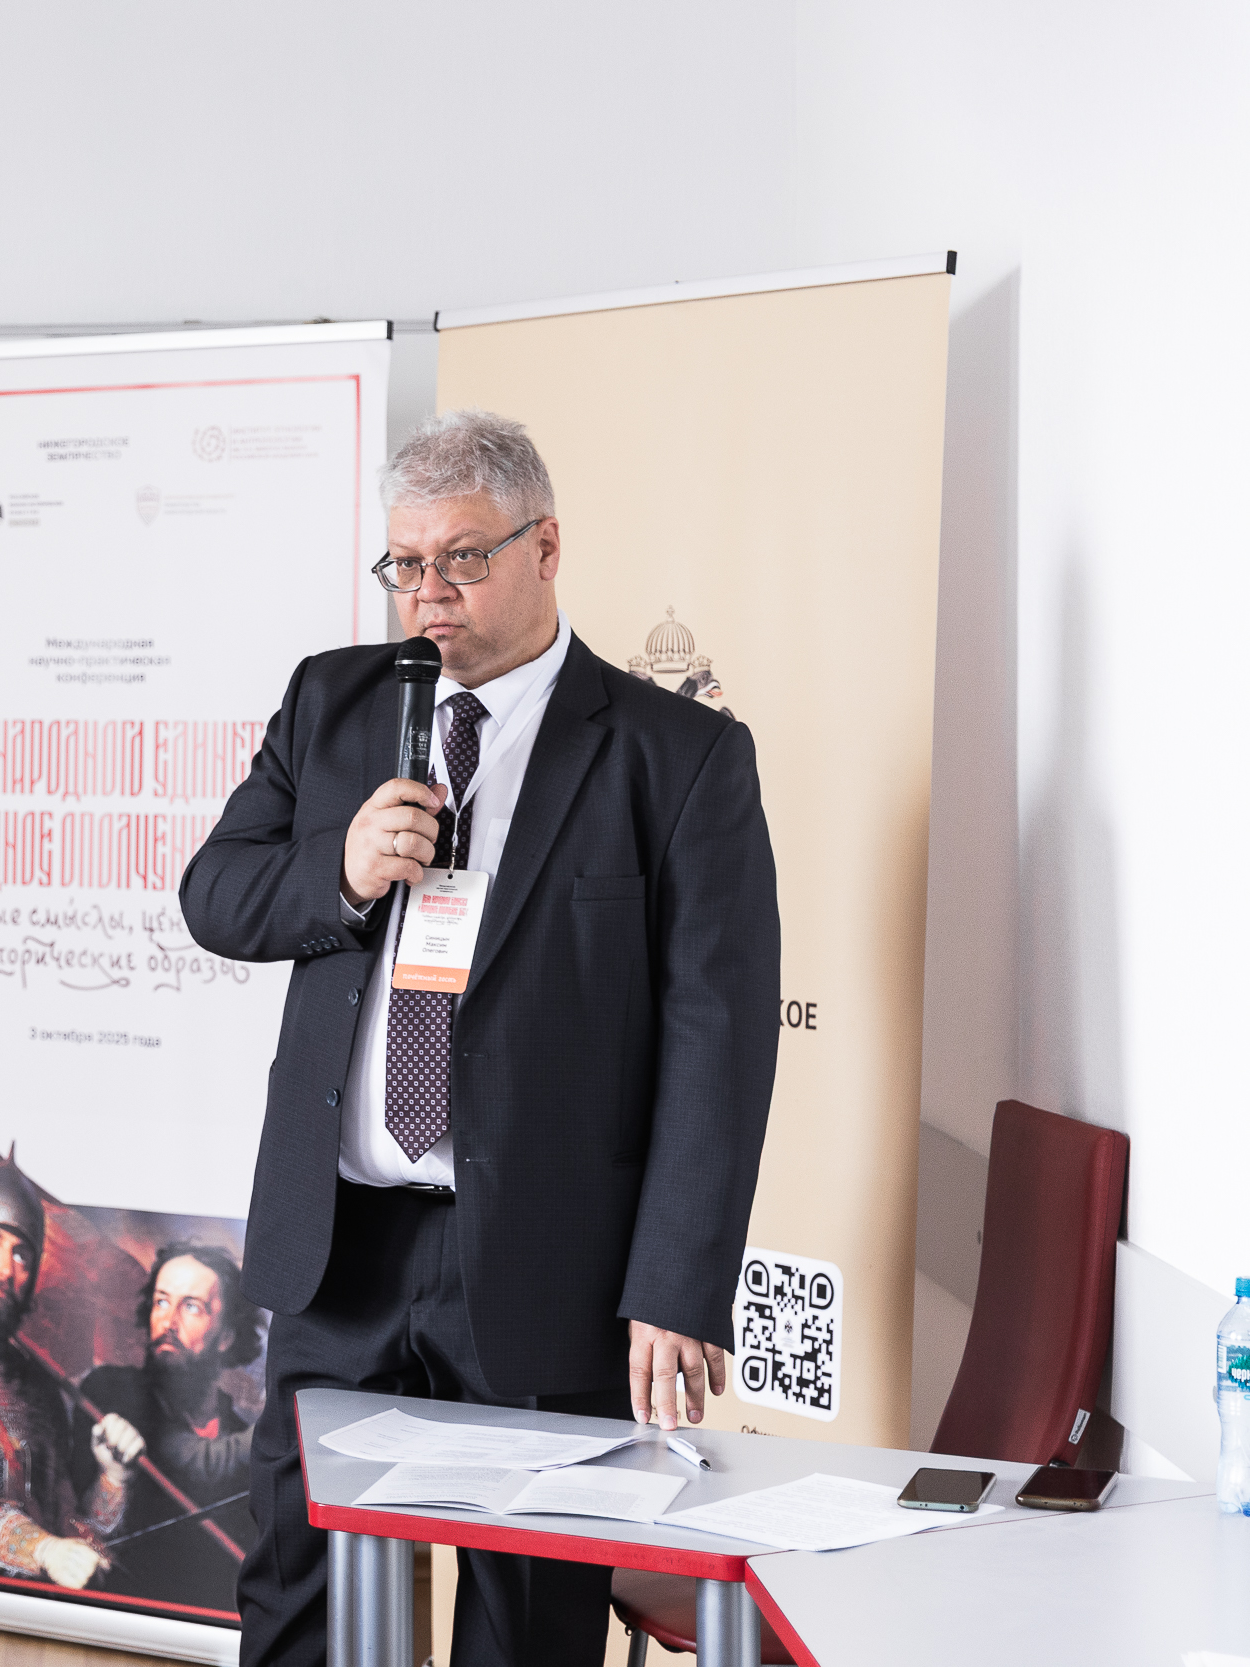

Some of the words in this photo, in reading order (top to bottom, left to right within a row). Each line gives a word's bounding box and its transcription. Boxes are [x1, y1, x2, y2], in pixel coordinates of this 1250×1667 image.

[45, 637, 155, 651] Международная
[28, 656, 171, 669] научно-практическая
[55, 673, 146, 686] конференция
[153, 719, 266, 806] ЕДИНСТ
[141, 905, 183, 942] цен
[28, 1026, 38, 1040] 3
[39, 1028, 94, 1046] октября
[97, 1030, 130, 1046] 2025
[131, 1034, 162, 1049] года
